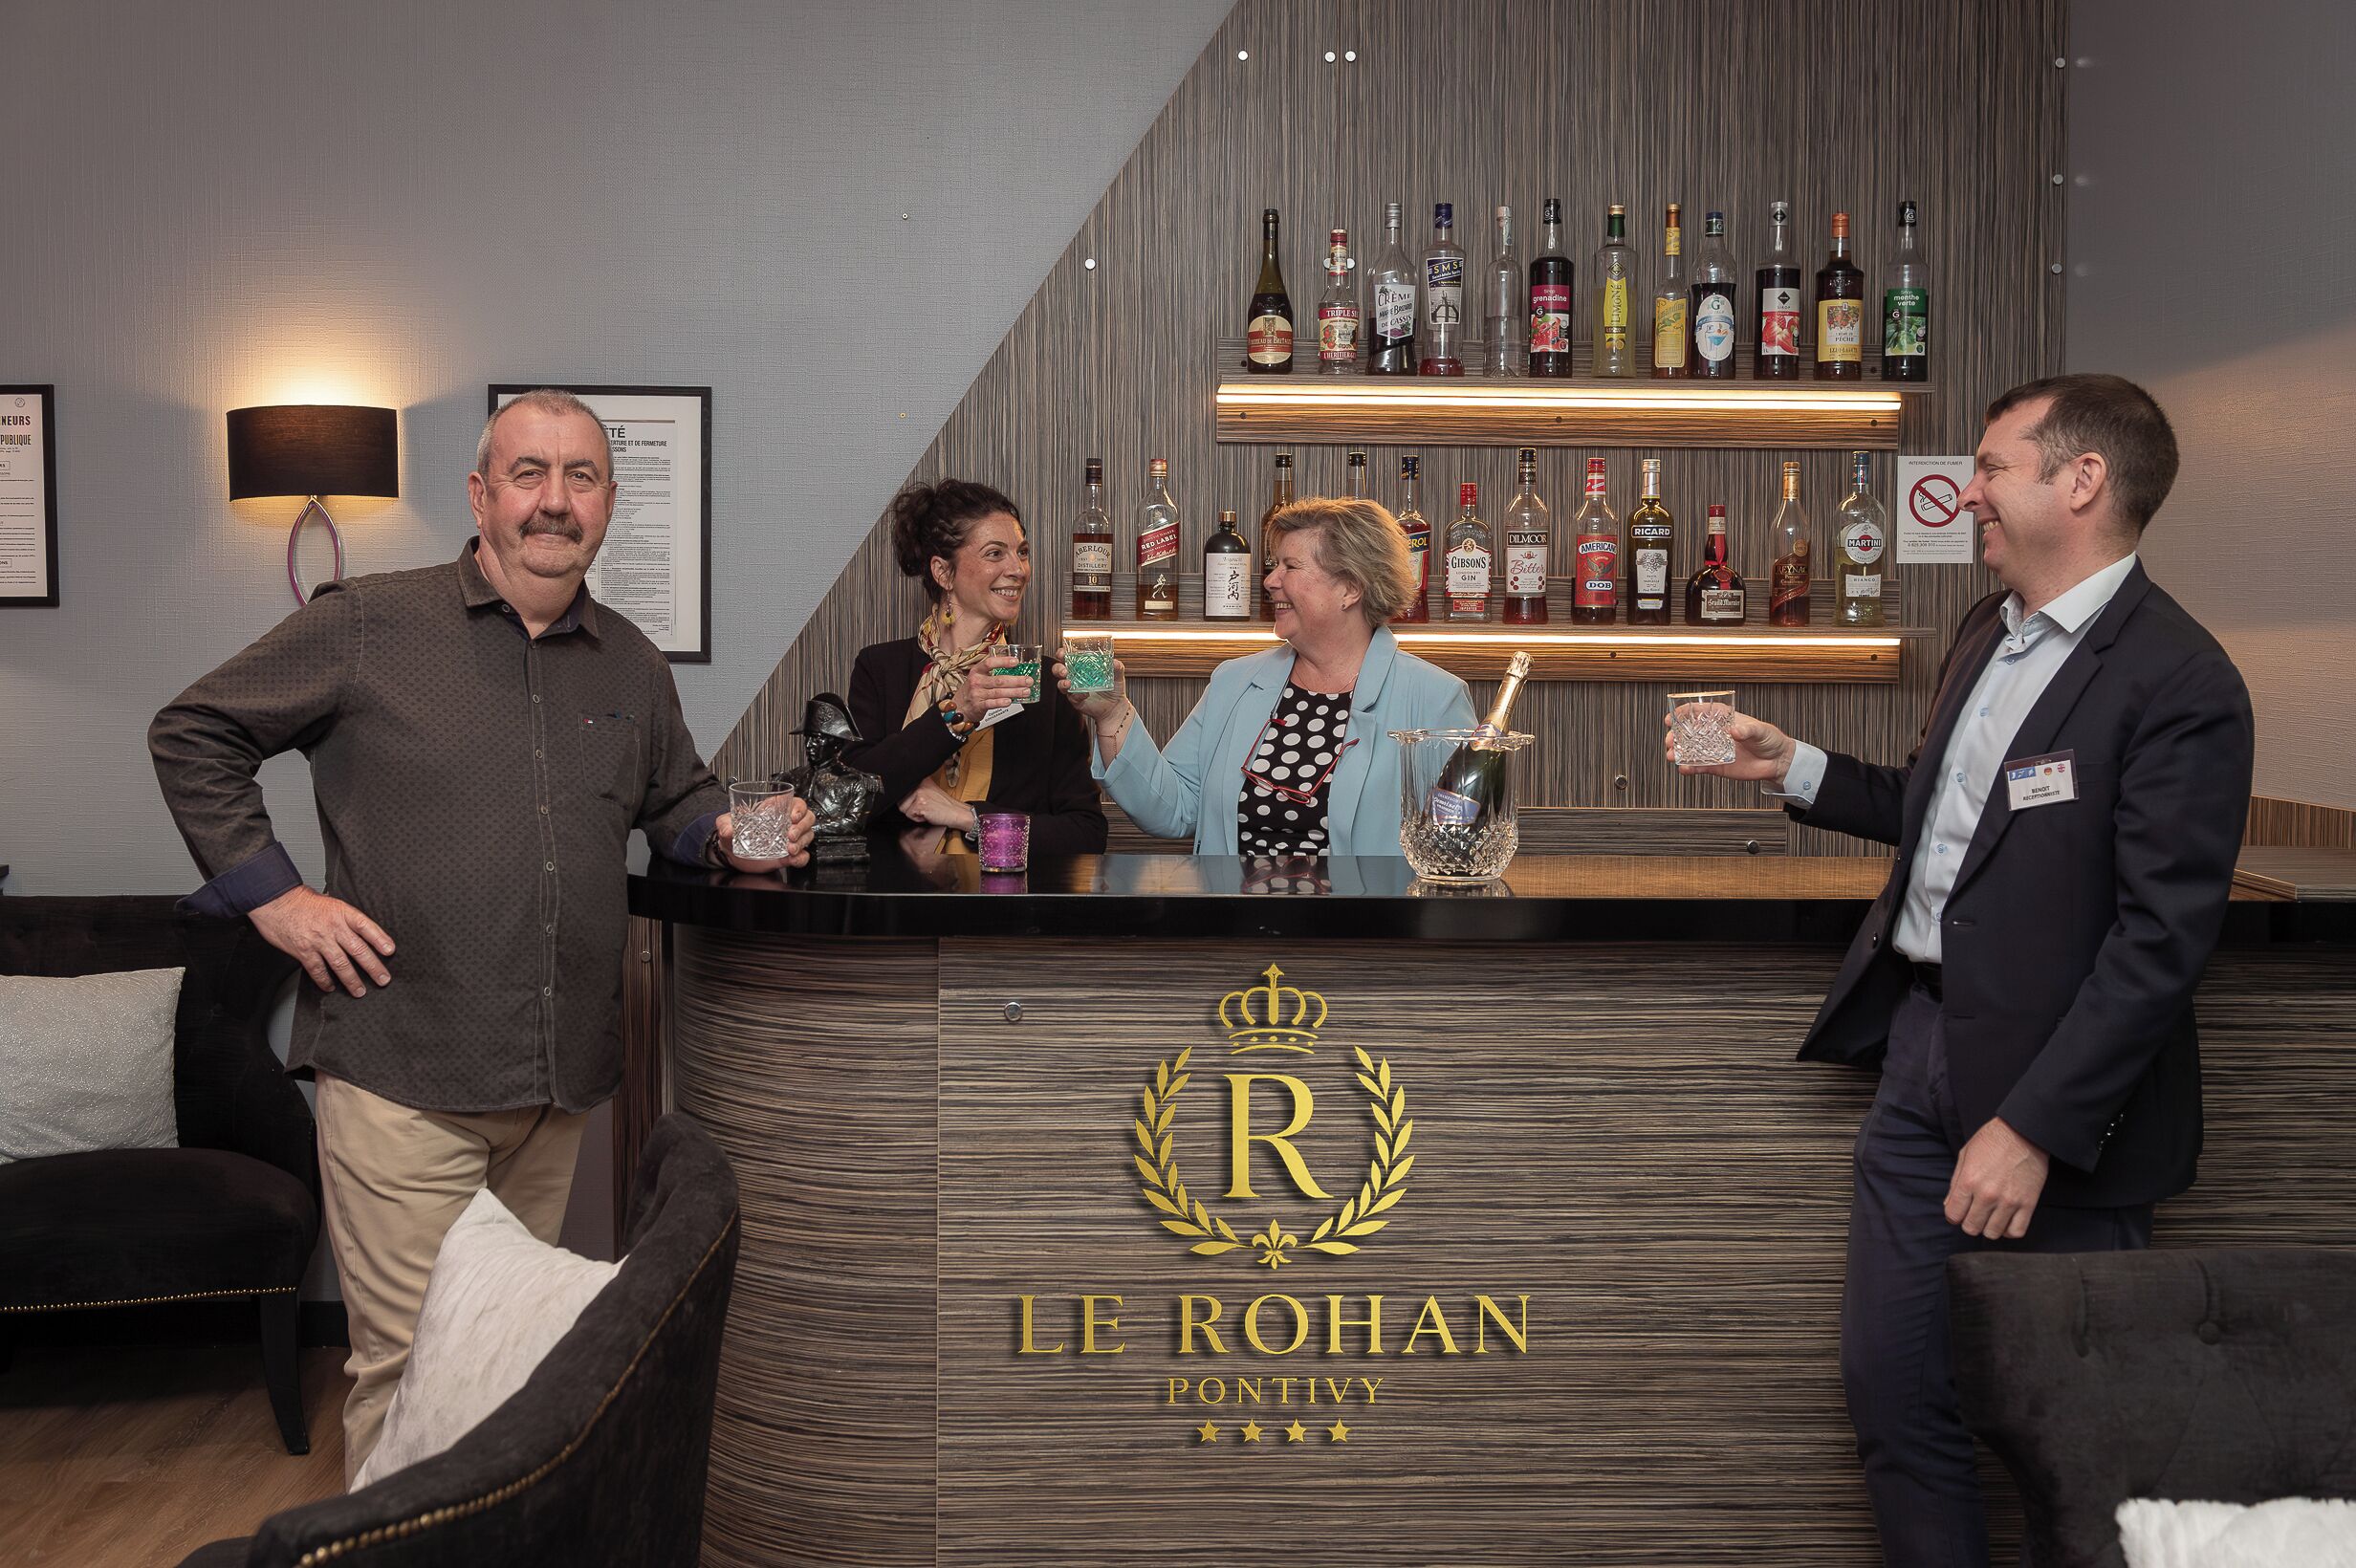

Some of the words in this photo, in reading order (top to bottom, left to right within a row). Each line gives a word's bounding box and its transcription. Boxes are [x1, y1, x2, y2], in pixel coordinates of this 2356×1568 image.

[1533, 294, 1567, 304] grenadine
[1326, 309, 1351, 317] TRIPLE
[1141, 541, 1155, 551] RED
[1156, 534, 1177, 545] LABEL
[1509, 534, 1547, 544] DILMOOR
[1075, 545, 1111, 559] ABERLOUR
[1451, 555, 1487, 570] GIBSON'S
[1510, 559, 1546, 576] Bitter
[1088, 576, 1098, 584] 10
[2031, 785, 2050, 794] BENOIT
[1222, 1074, 1334, 1198] R
[1018, 1294, 1126, 1355] LE
[1178, 1294, 1531, 1355] ROHAN
[1167, 1377, 1385, 1405] PONTIVY
